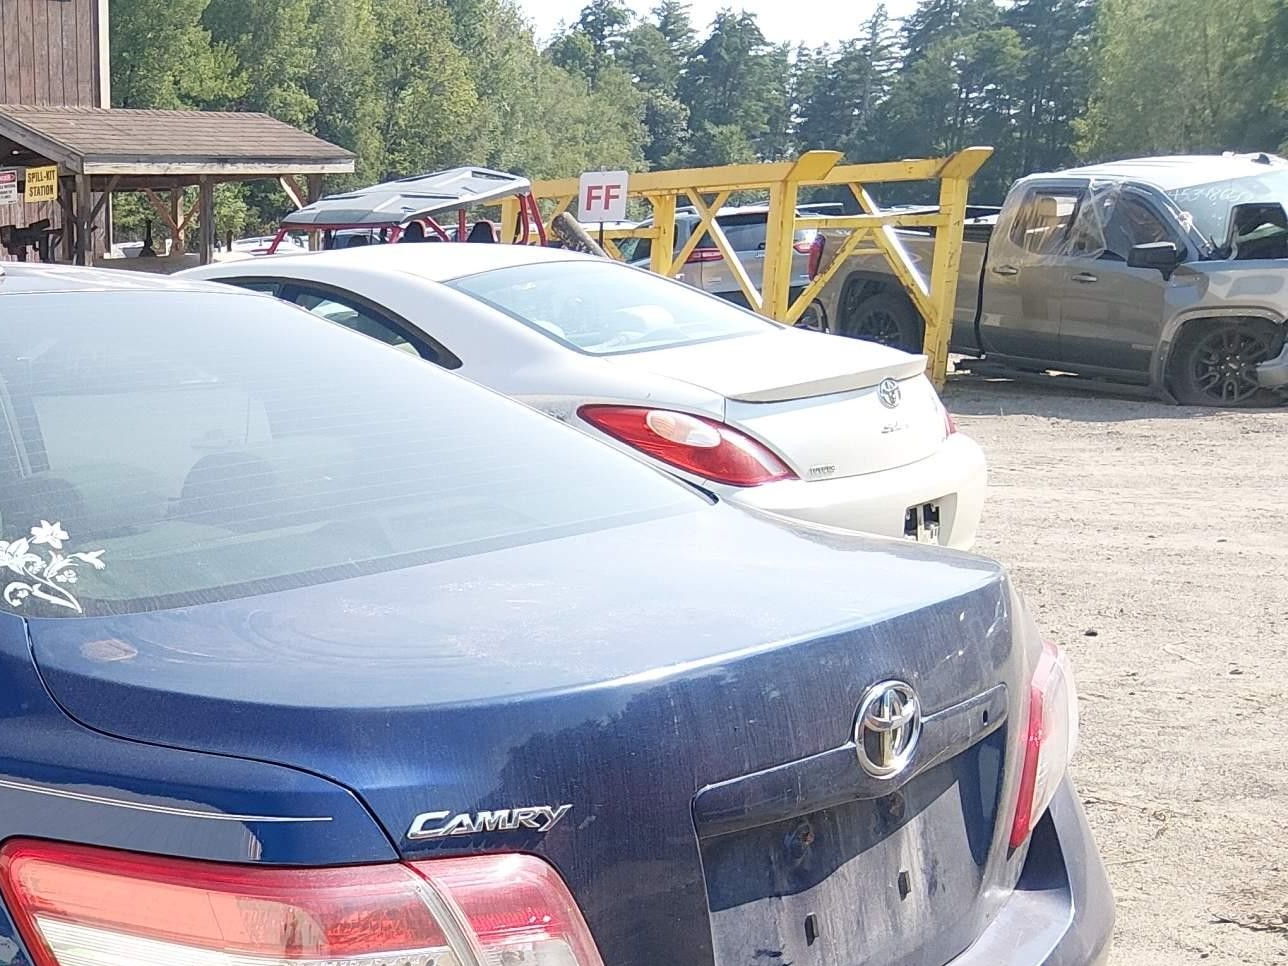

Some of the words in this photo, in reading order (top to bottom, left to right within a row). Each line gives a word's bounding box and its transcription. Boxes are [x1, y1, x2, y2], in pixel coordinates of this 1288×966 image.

[27, 169, 56, 183] SPILL-KIT
[29, 184, 54, 197] STATION
[586, 185, 621, 211] FF
[407, 804, 573, 840] CAMRY
